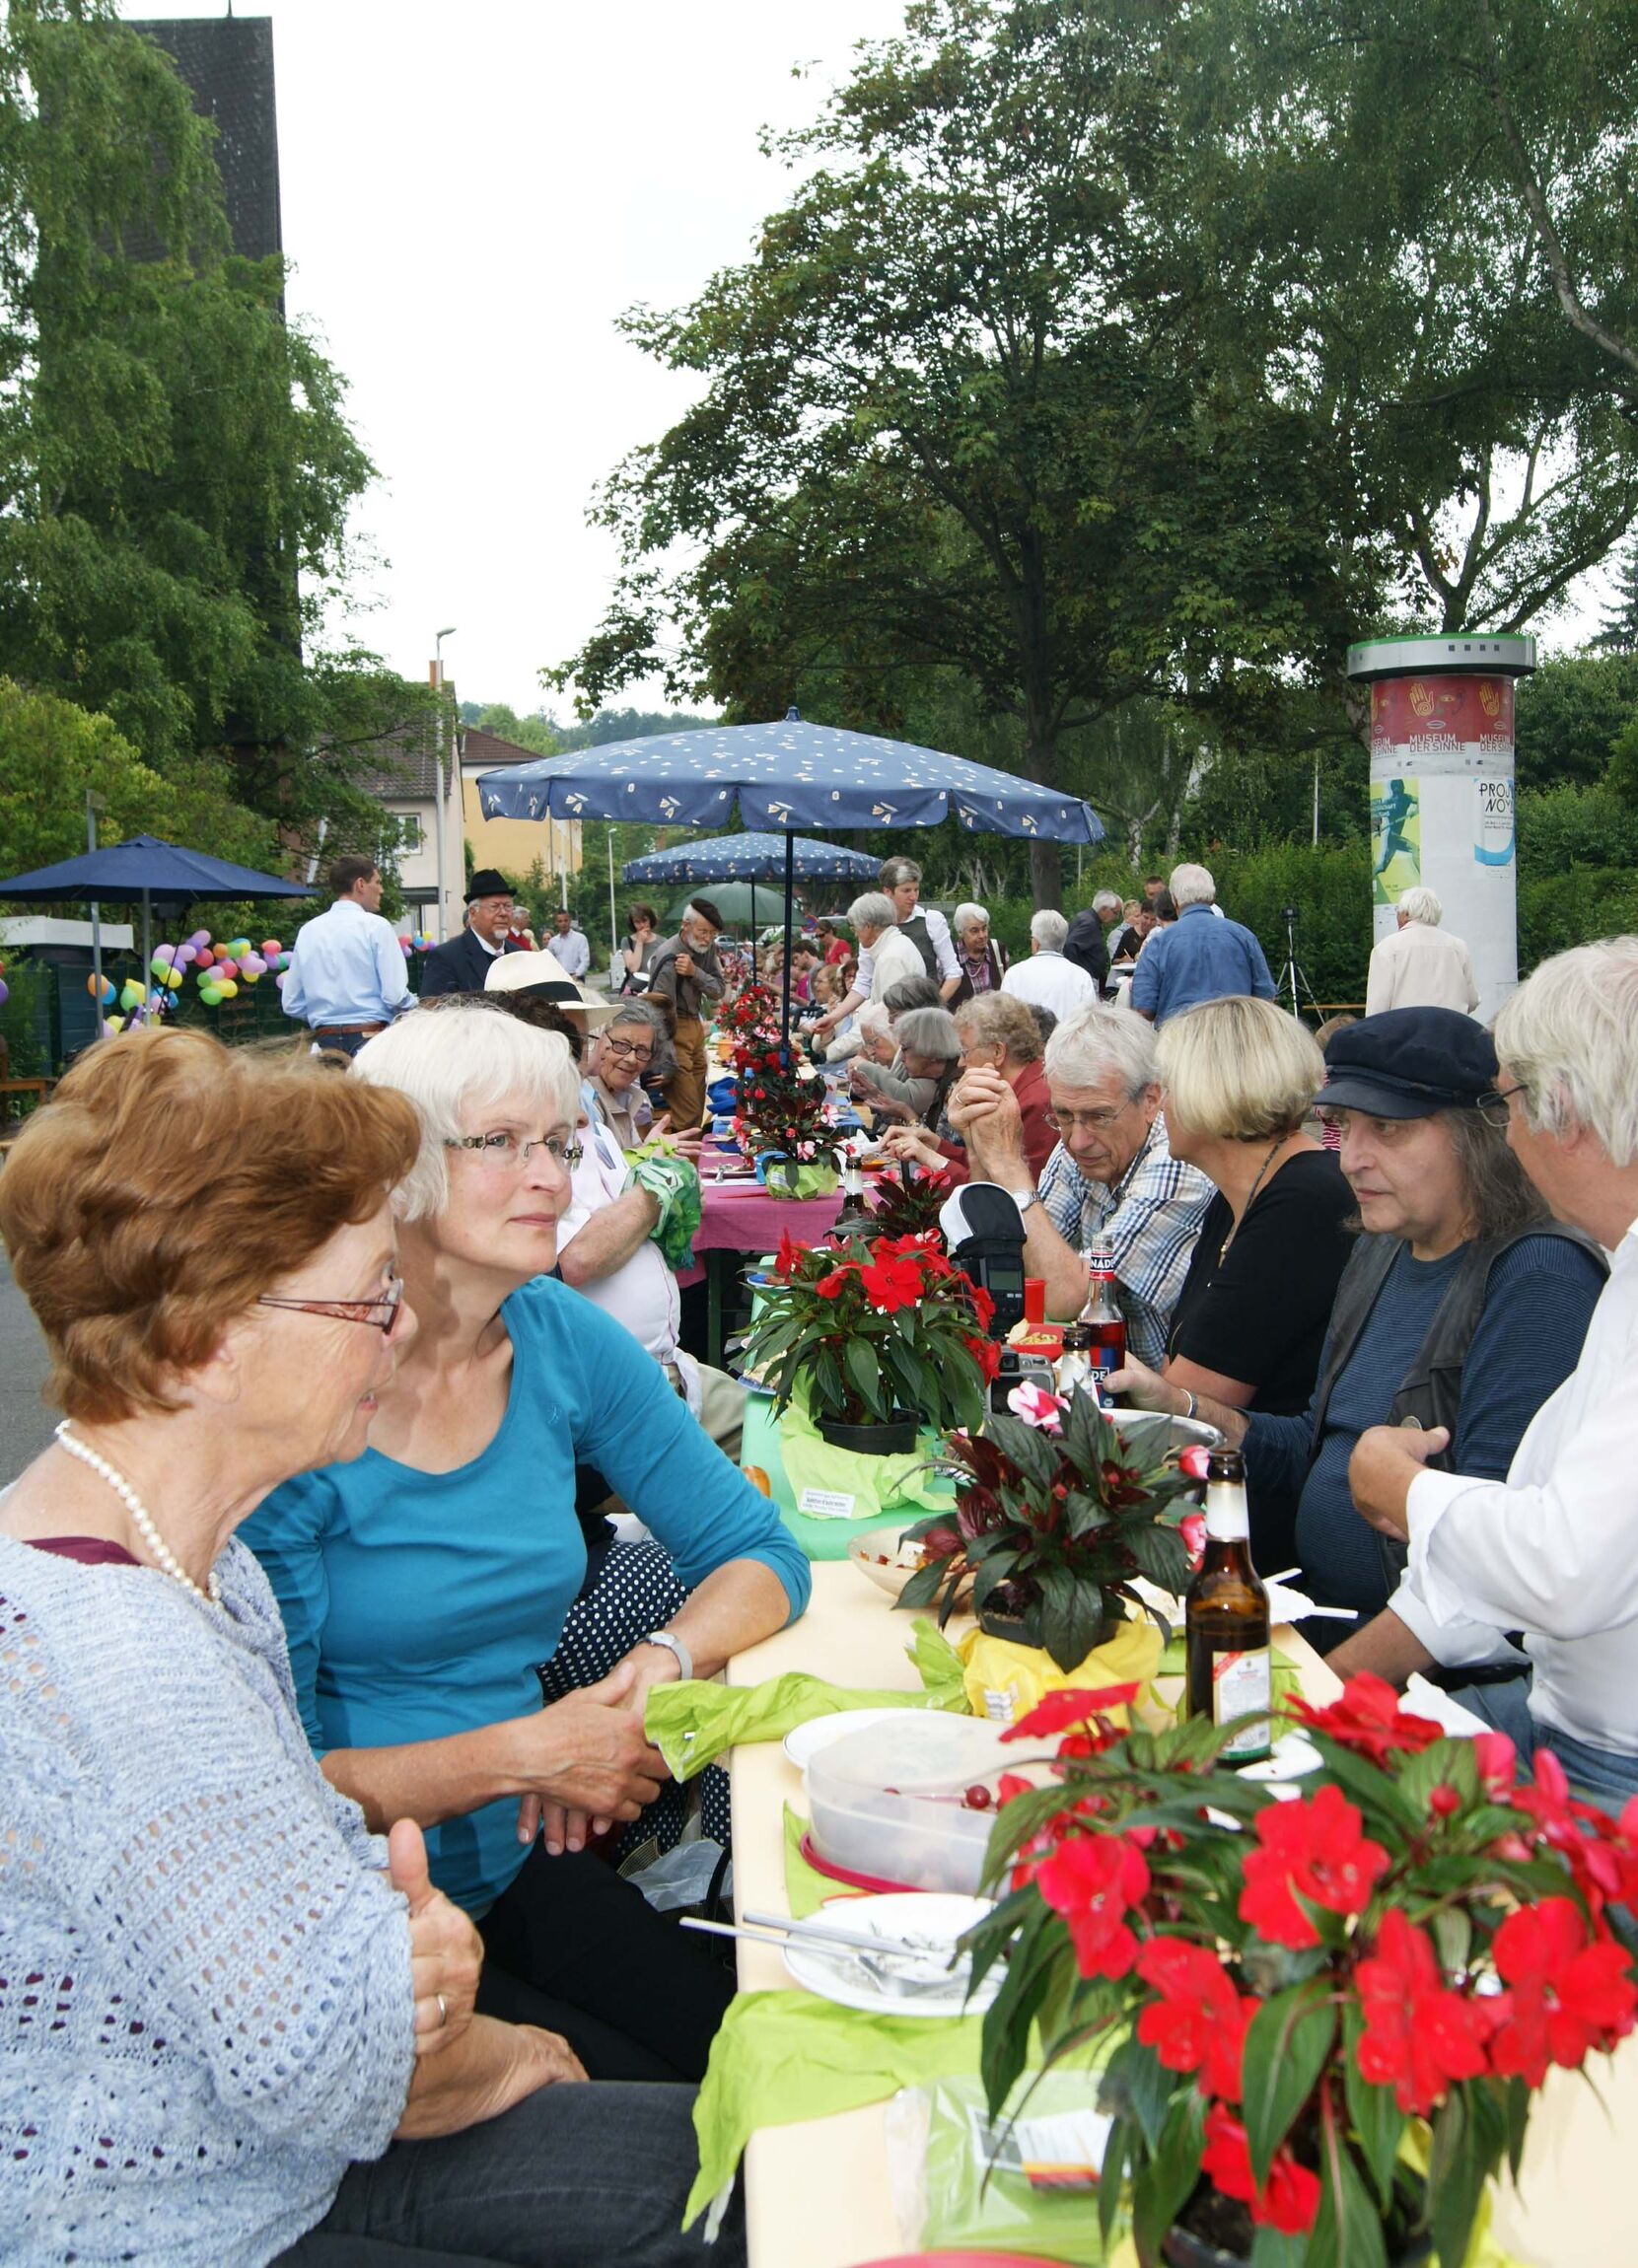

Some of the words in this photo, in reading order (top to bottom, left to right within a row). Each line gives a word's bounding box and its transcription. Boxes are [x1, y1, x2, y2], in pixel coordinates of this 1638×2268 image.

[1409, 733, 1457, 744] MUSEUM
[1409, 743, 1433, 752] DER
[1434, 742, 1466, 751] SINNE
[1480, 742, 1497, 752] DER
